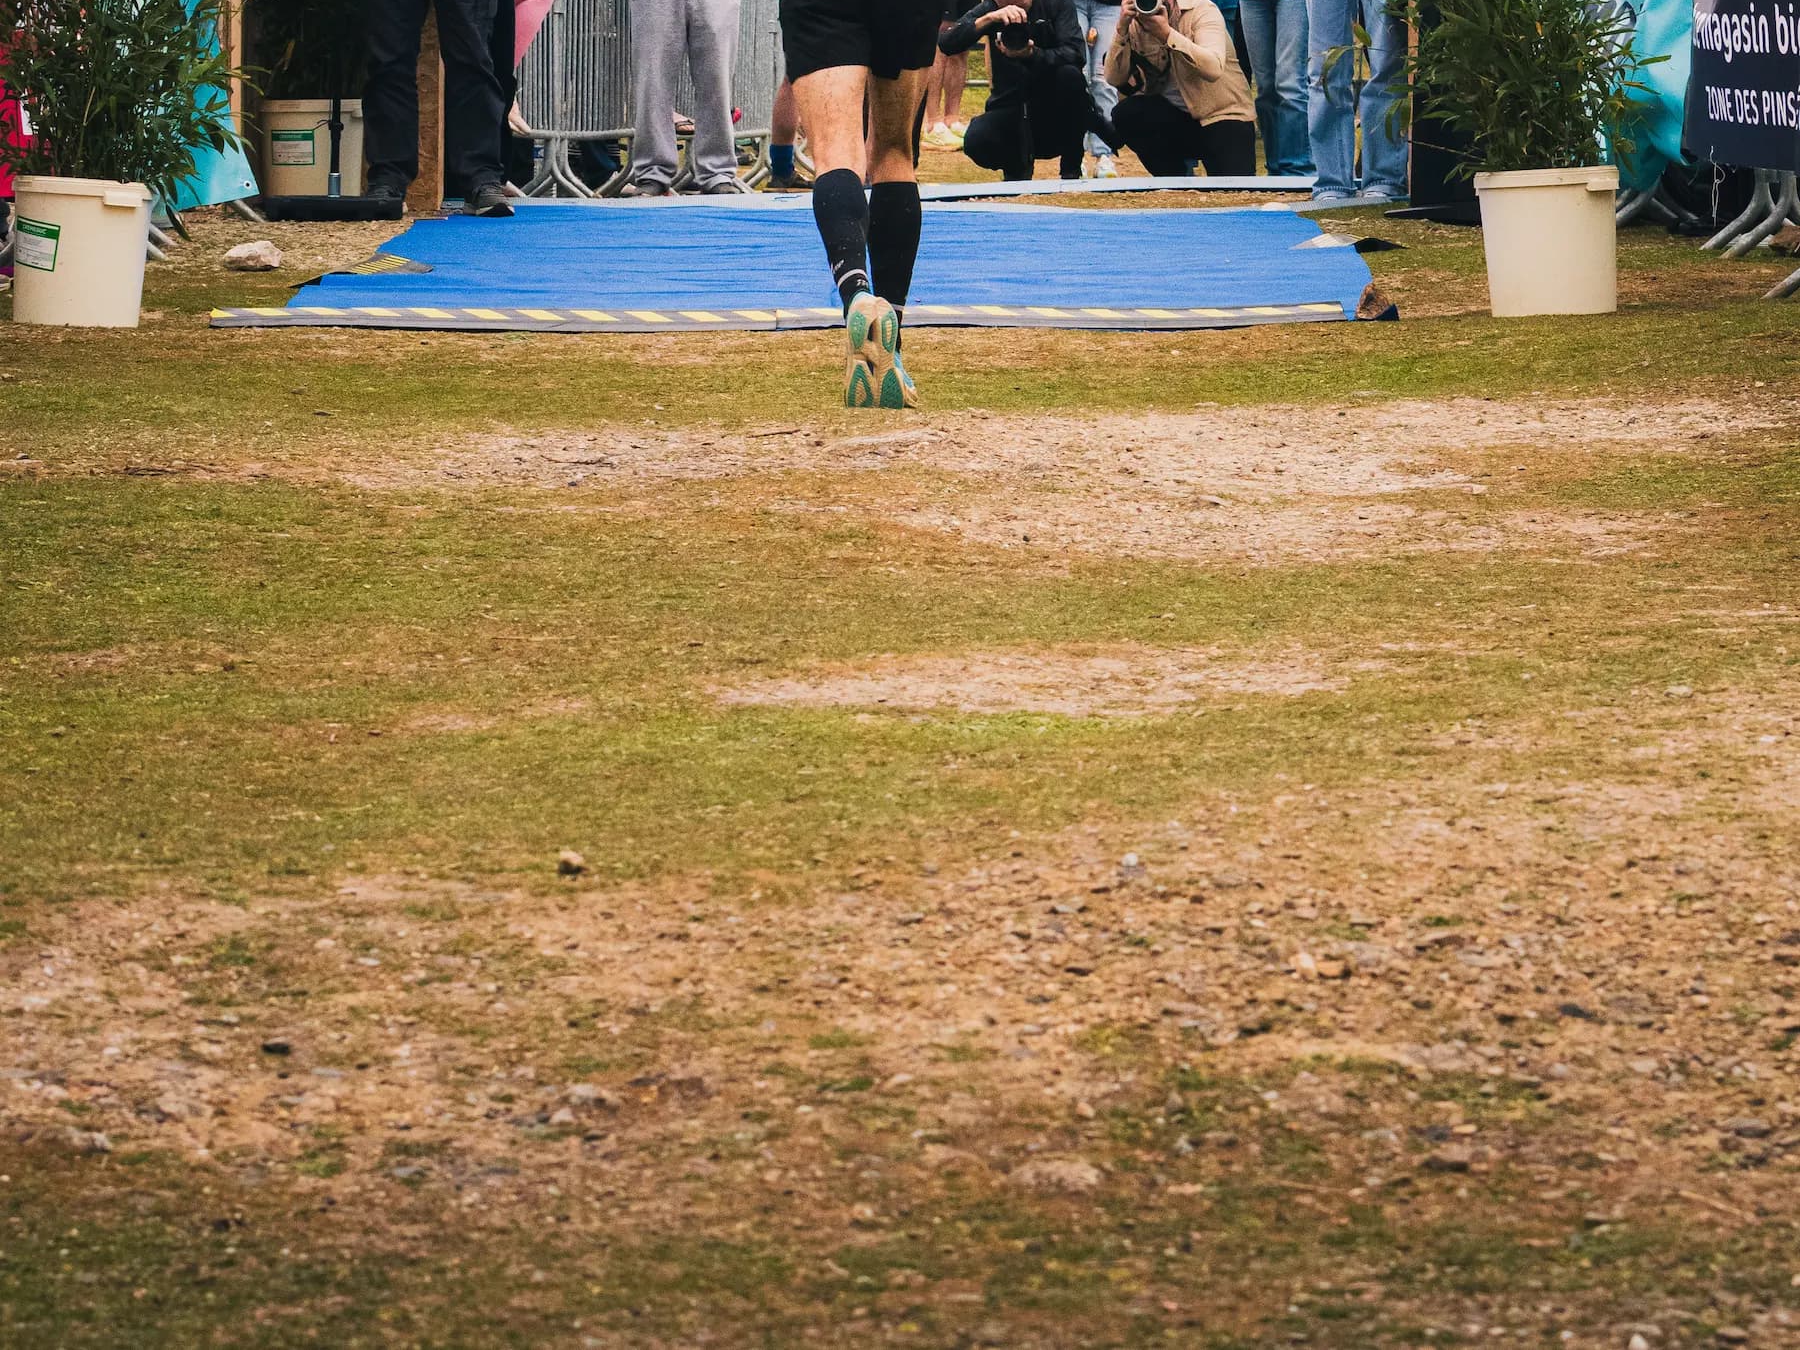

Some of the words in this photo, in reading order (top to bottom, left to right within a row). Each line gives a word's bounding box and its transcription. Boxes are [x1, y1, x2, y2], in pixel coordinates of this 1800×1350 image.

[1775, 2, 1800, 57] bi
[1705, 86, 1734, 123] ZONE
[1734, 89, 1759, 125] DES
